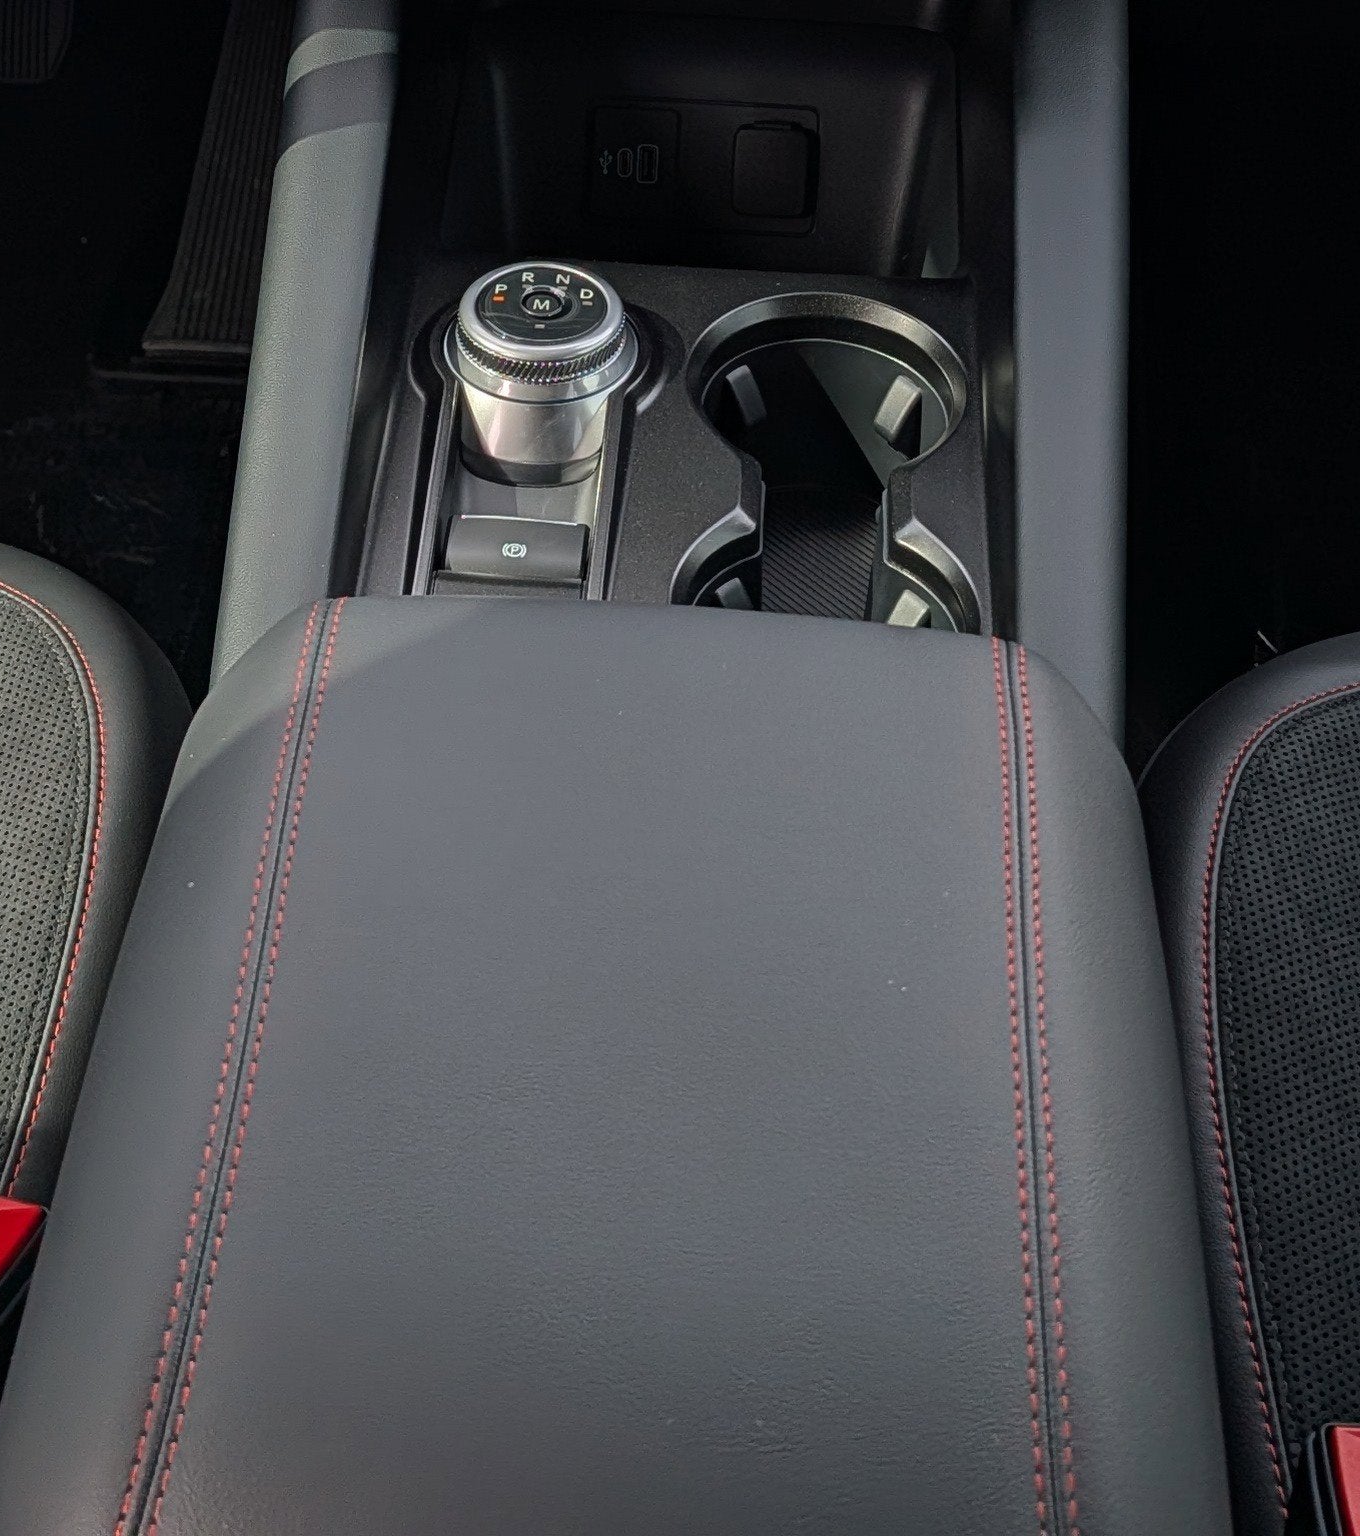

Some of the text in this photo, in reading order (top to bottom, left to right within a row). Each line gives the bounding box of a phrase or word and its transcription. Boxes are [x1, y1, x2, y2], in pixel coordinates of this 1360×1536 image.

[522, 272, 534, 282] R
[556, 274, 570, 284] N
[495, 284, 507, 294] P
[580, 289, 593, 299] D
[533, 299, 550, 310] M
